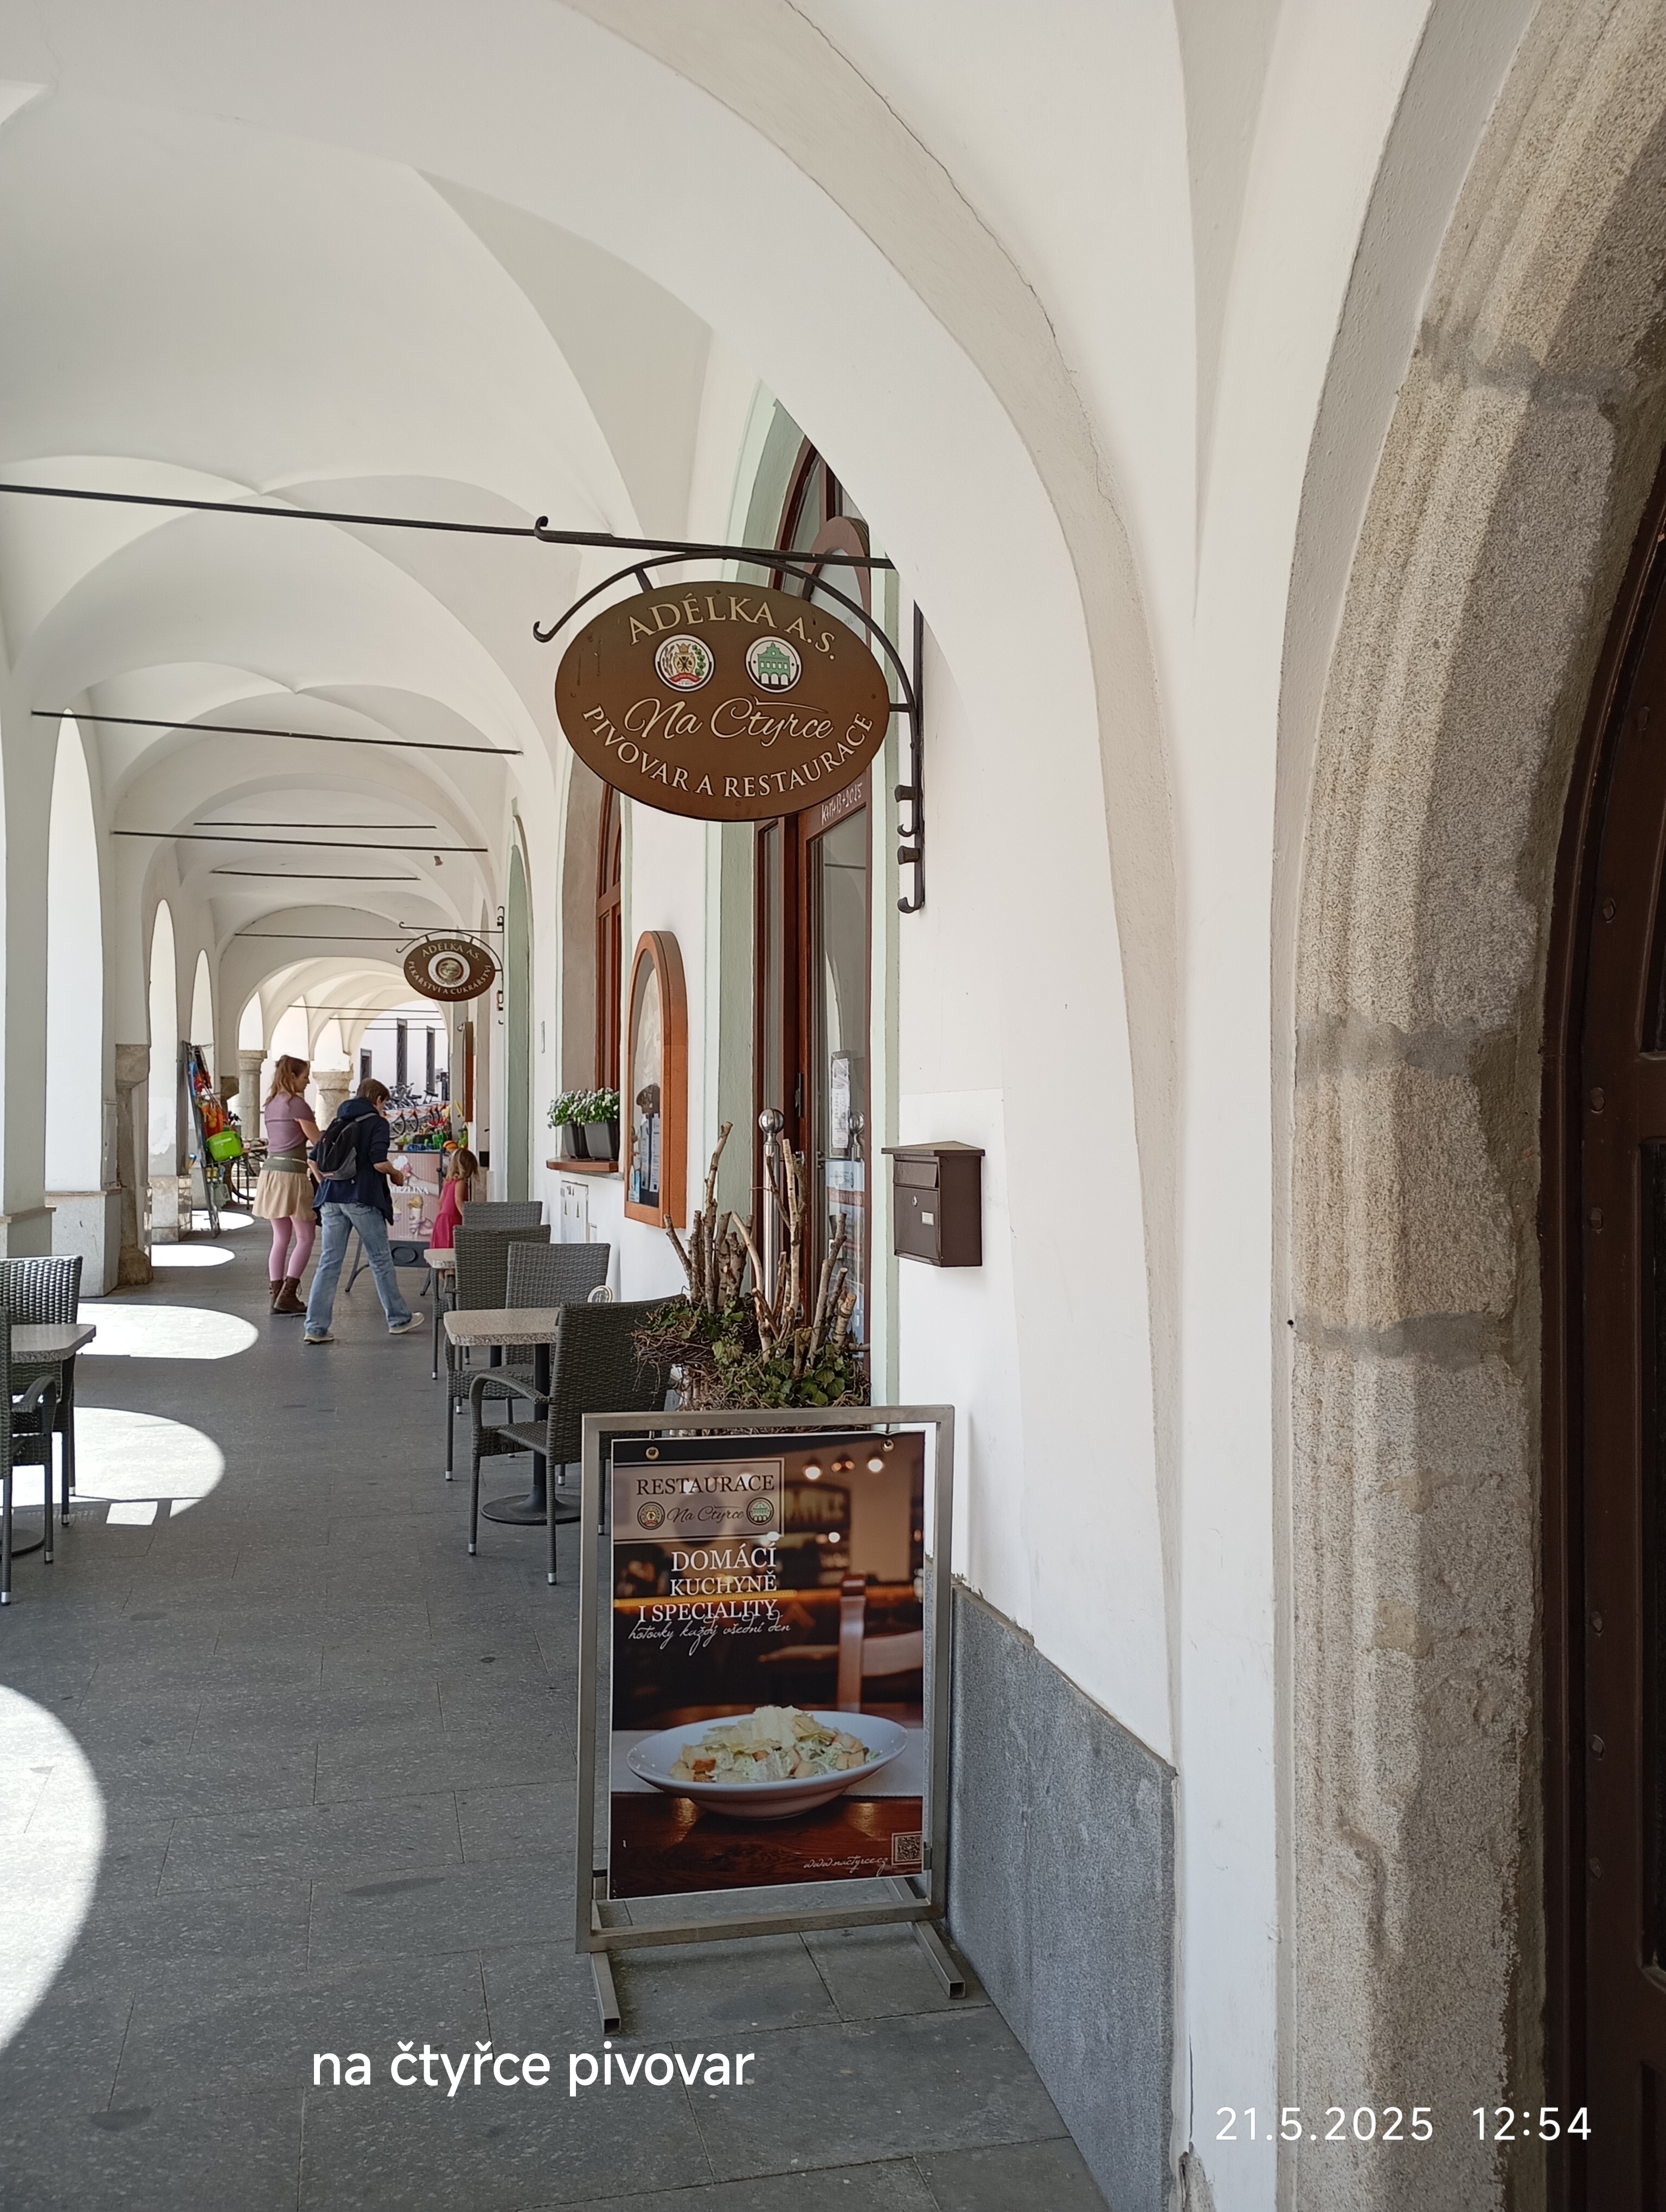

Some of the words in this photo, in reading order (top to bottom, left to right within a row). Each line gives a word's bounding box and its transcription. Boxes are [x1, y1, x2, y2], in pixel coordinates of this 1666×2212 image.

[629, 592, 778, 645] ADÉLKA
[784, 616, 836, 660] A.S.
[624, 698, 703, 740] Na
[582, 704, 690, 792] PIVOVAR
[694, 774, 715, 796] A
[724, 712, 873, 798] RESTAURACE
[636, 1474, 775, 1495] RESTAURACE
[667, 1507, 695, 1523] Na
[670, 1542, 777, 1572] DOMÁCÍ
[670, 1570, 777, 1597] KUCHYNĚ
[638, 1605, 646, 1623] I
[652, 1599, 778, 1622] SPECIALITY
